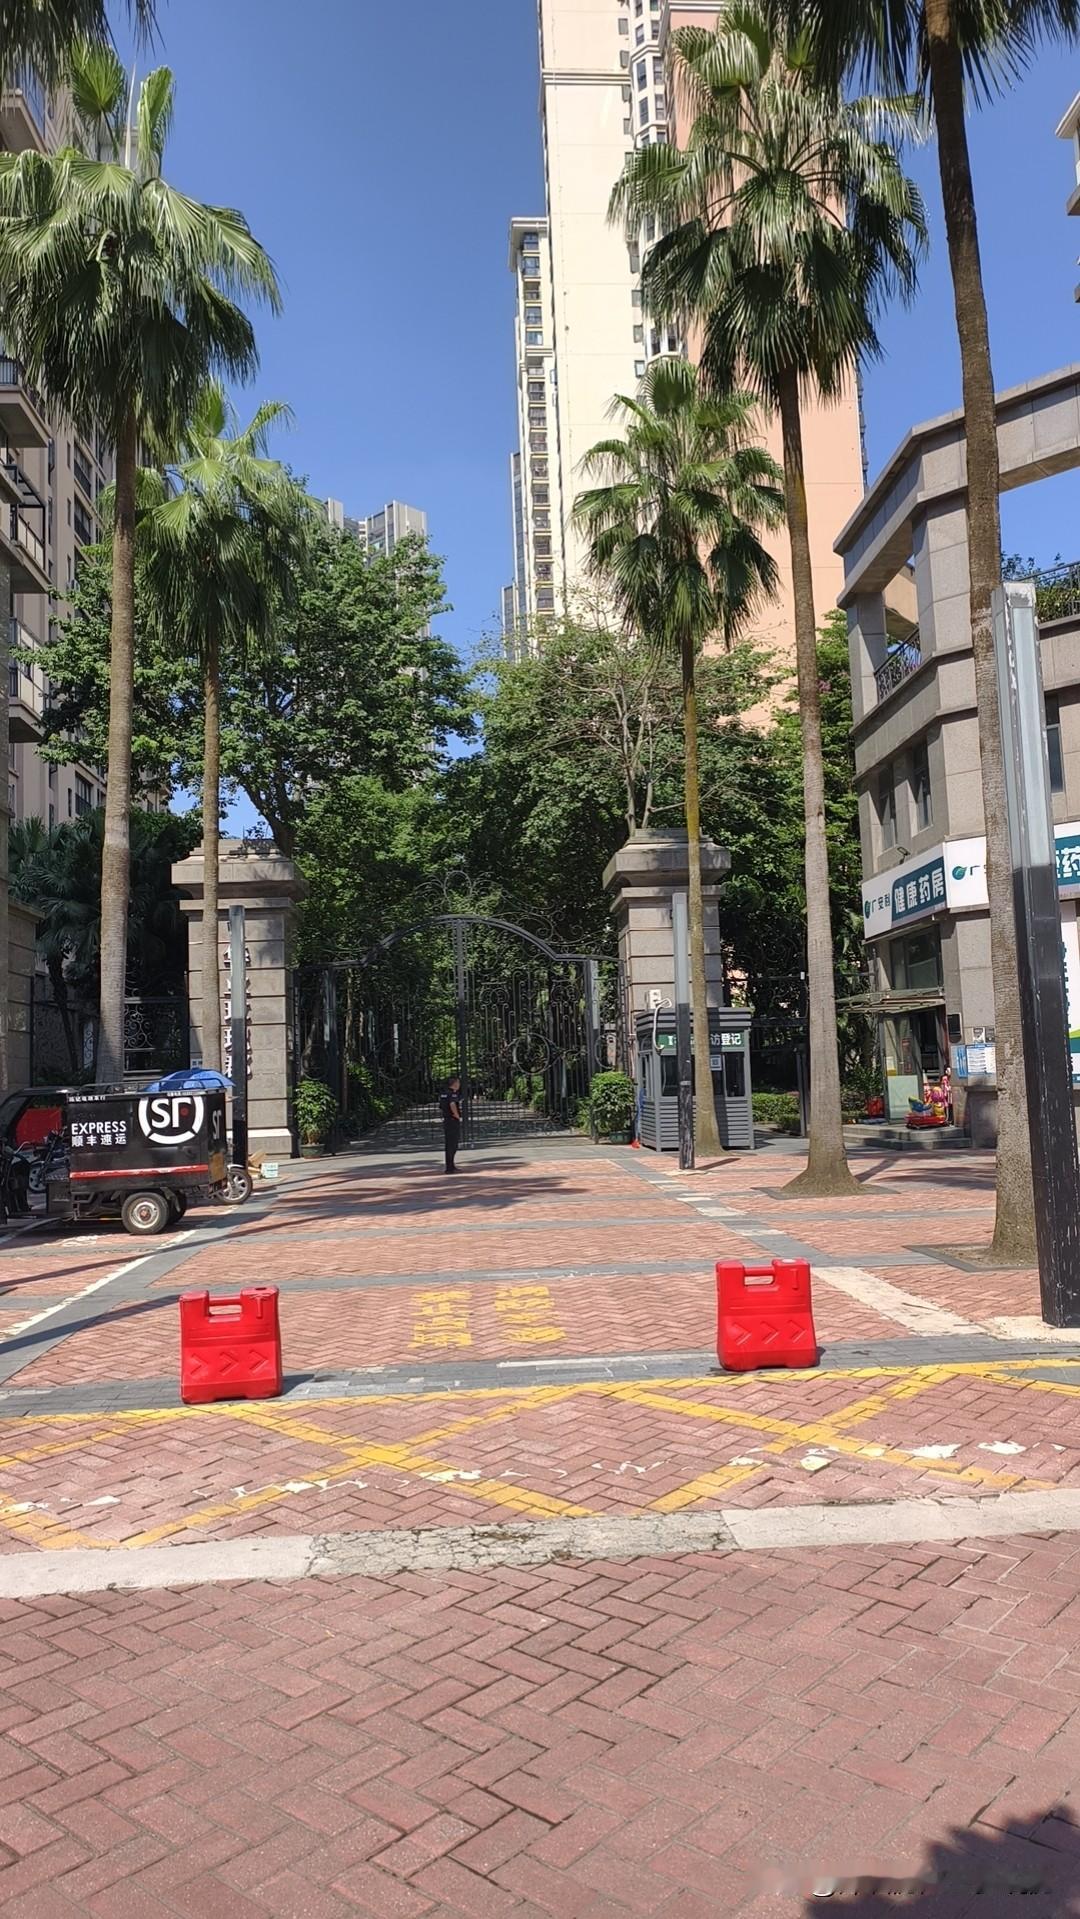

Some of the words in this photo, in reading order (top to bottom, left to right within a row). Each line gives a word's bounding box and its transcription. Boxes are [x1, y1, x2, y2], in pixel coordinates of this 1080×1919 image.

[894, 867, 945, 914] 健康药房
[71, 1120, 127, 1136] EXPRESS
[71, 1134, 127, 1147] 顺丰速运
